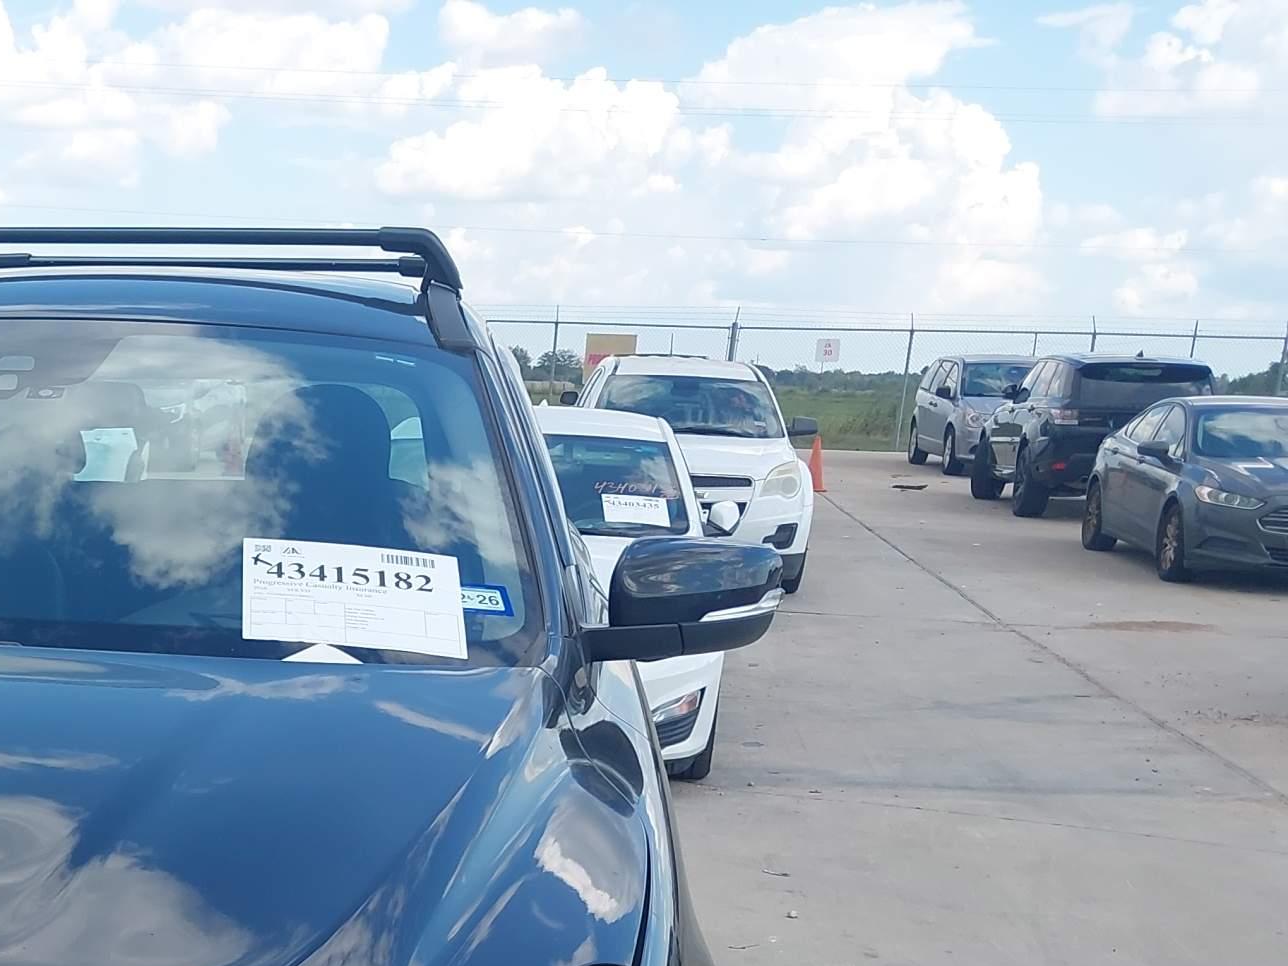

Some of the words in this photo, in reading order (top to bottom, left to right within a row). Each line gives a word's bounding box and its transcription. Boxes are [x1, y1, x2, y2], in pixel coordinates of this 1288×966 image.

[253, 577, 304, 588] Progressive
[305, 580, 343, 591] Casualty
[345, 585, 388, 595] Insurance
[266, 561, 434, 593] 43415182
[475, 594, 500, 606] 26
